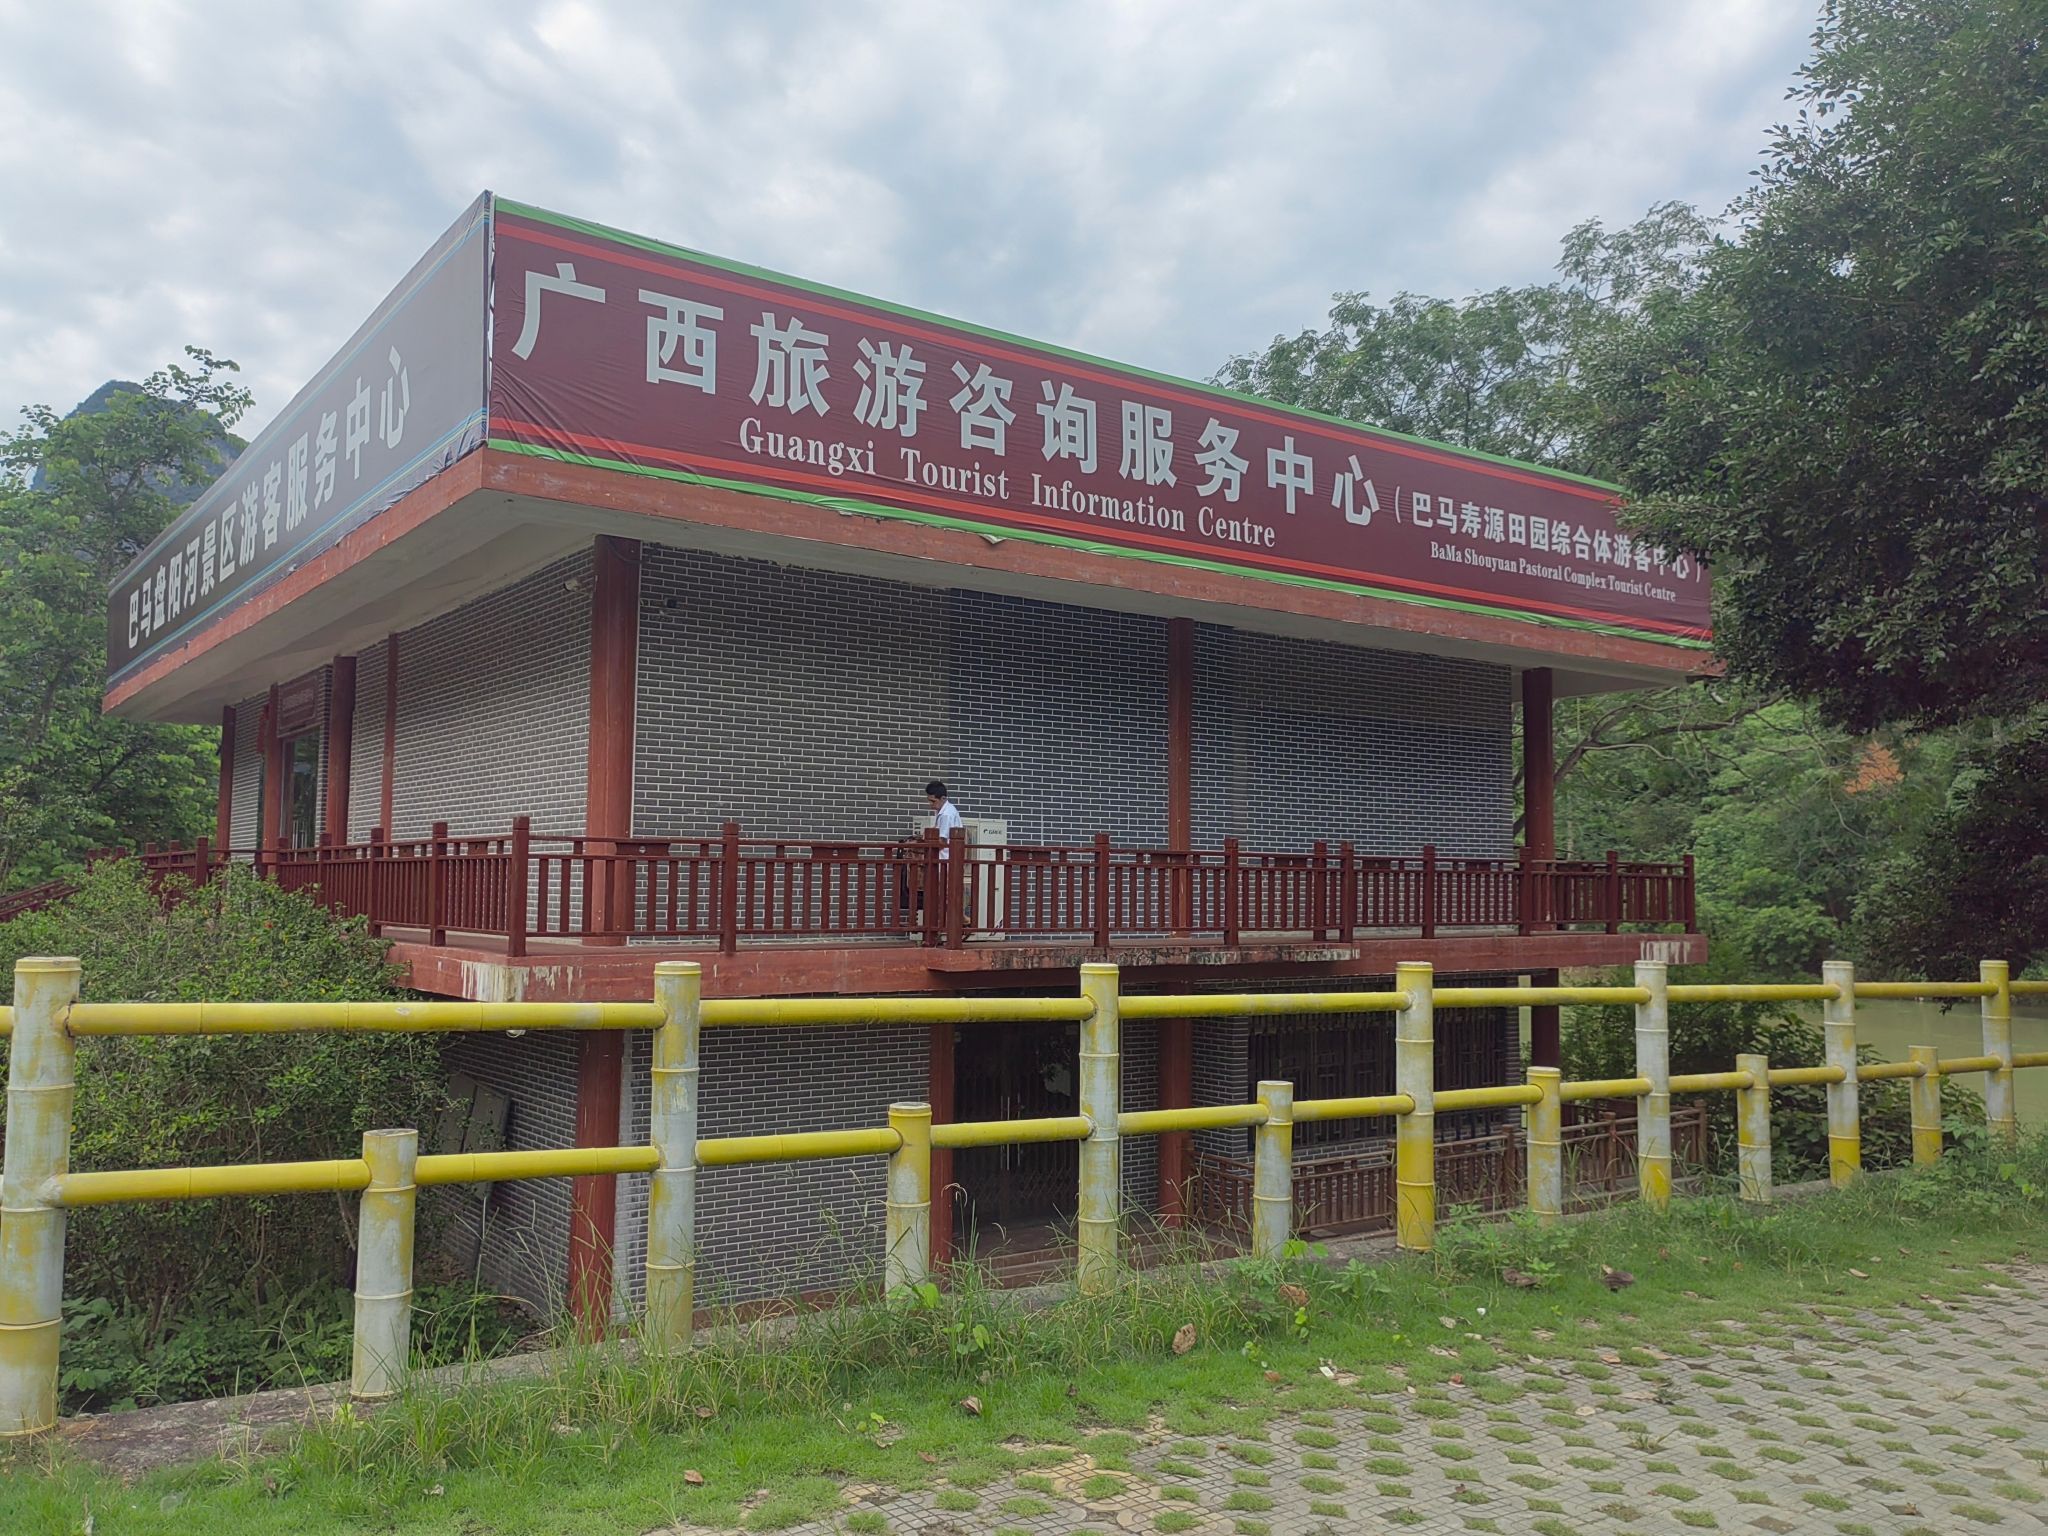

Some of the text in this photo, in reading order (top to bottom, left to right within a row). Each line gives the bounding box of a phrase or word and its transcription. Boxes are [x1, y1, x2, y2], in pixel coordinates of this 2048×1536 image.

[511, 262, 1380, 526] 广西旅游咨询服务中心
[738, 417, 1276, 548] Guangxi Tourist Information Centre
[128, 345, 411, 649] 巴马盘阳河景区游客服务中心
[1430, 541, 1677, 602] BaMa Shouyuan Pastoral Complex Tourist Centre
